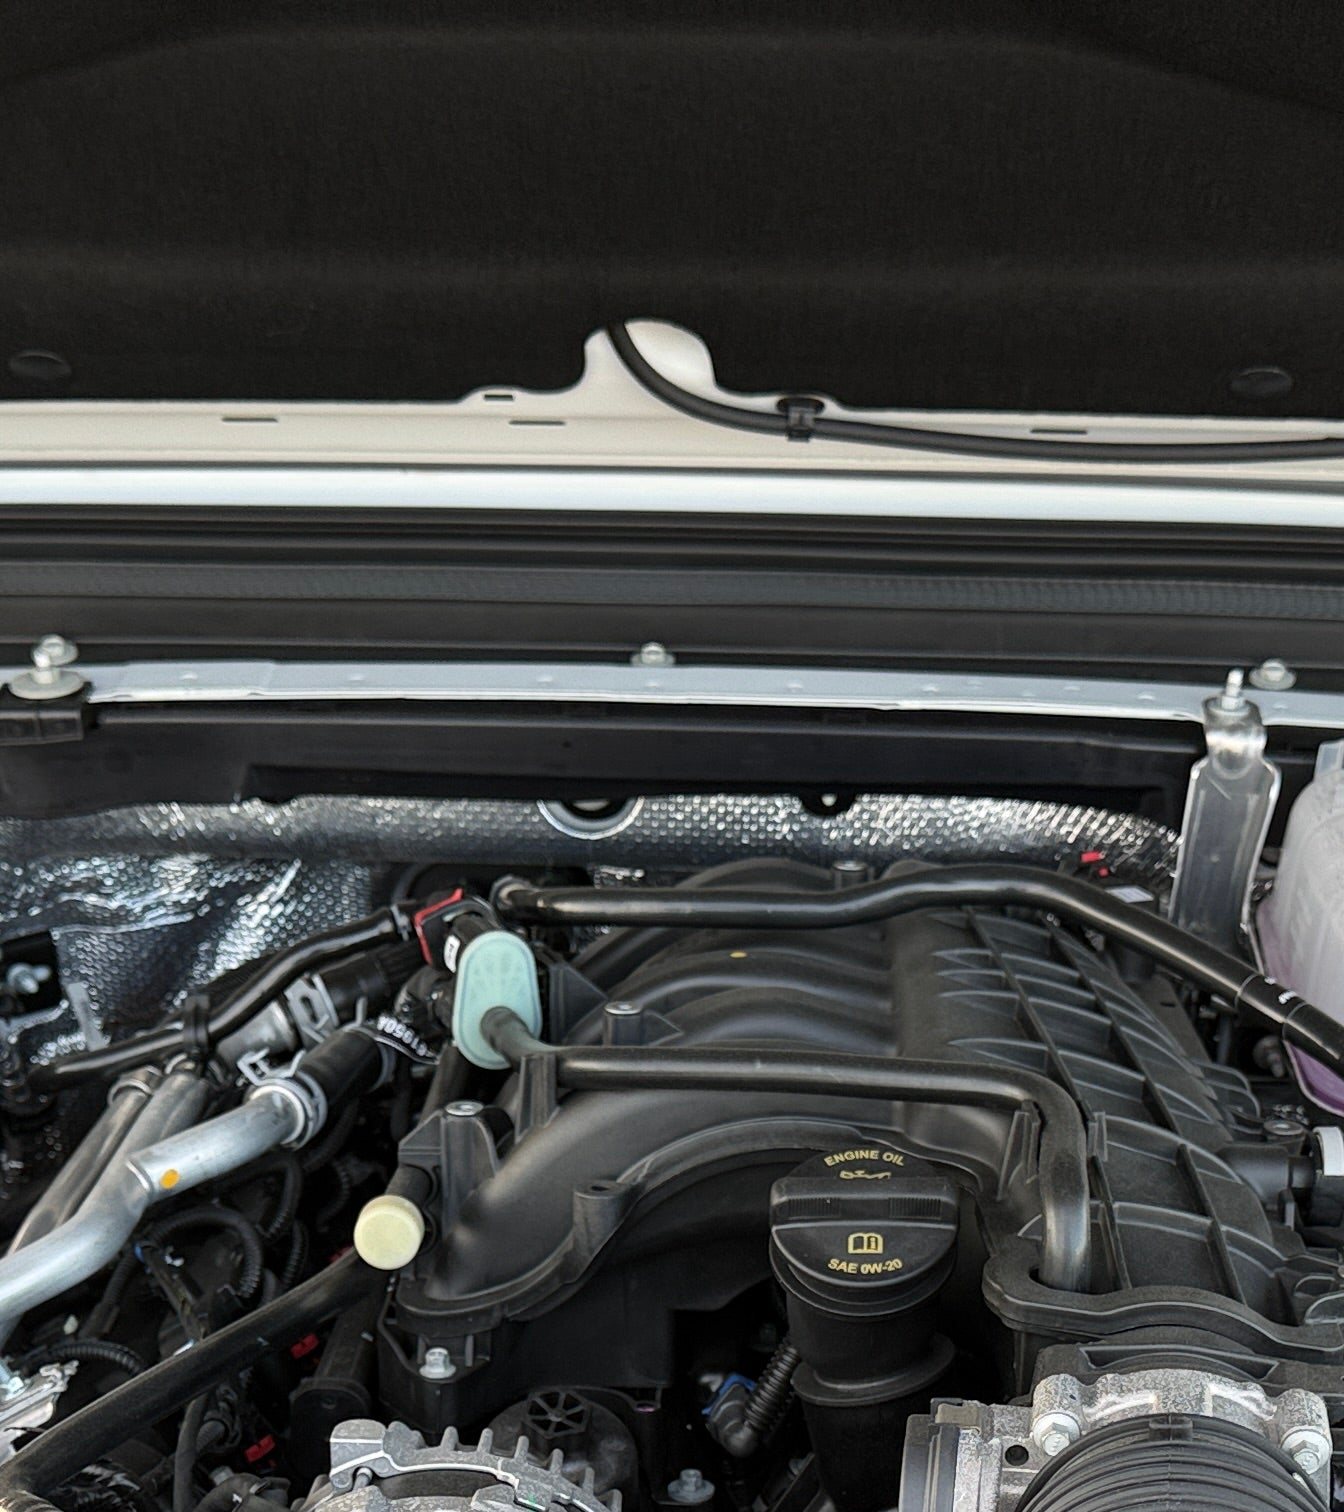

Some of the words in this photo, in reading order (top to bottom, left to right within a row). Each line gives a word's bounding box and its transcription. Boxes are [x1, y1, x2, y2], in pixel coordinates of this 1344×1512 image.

[824, 1150, 879, 1166] ENGINE
[882, 1152, 905, 1166] OIL
[828, 1258, 857, 1274] SAE
[860, 1258, 903, 1275] 0W-20
